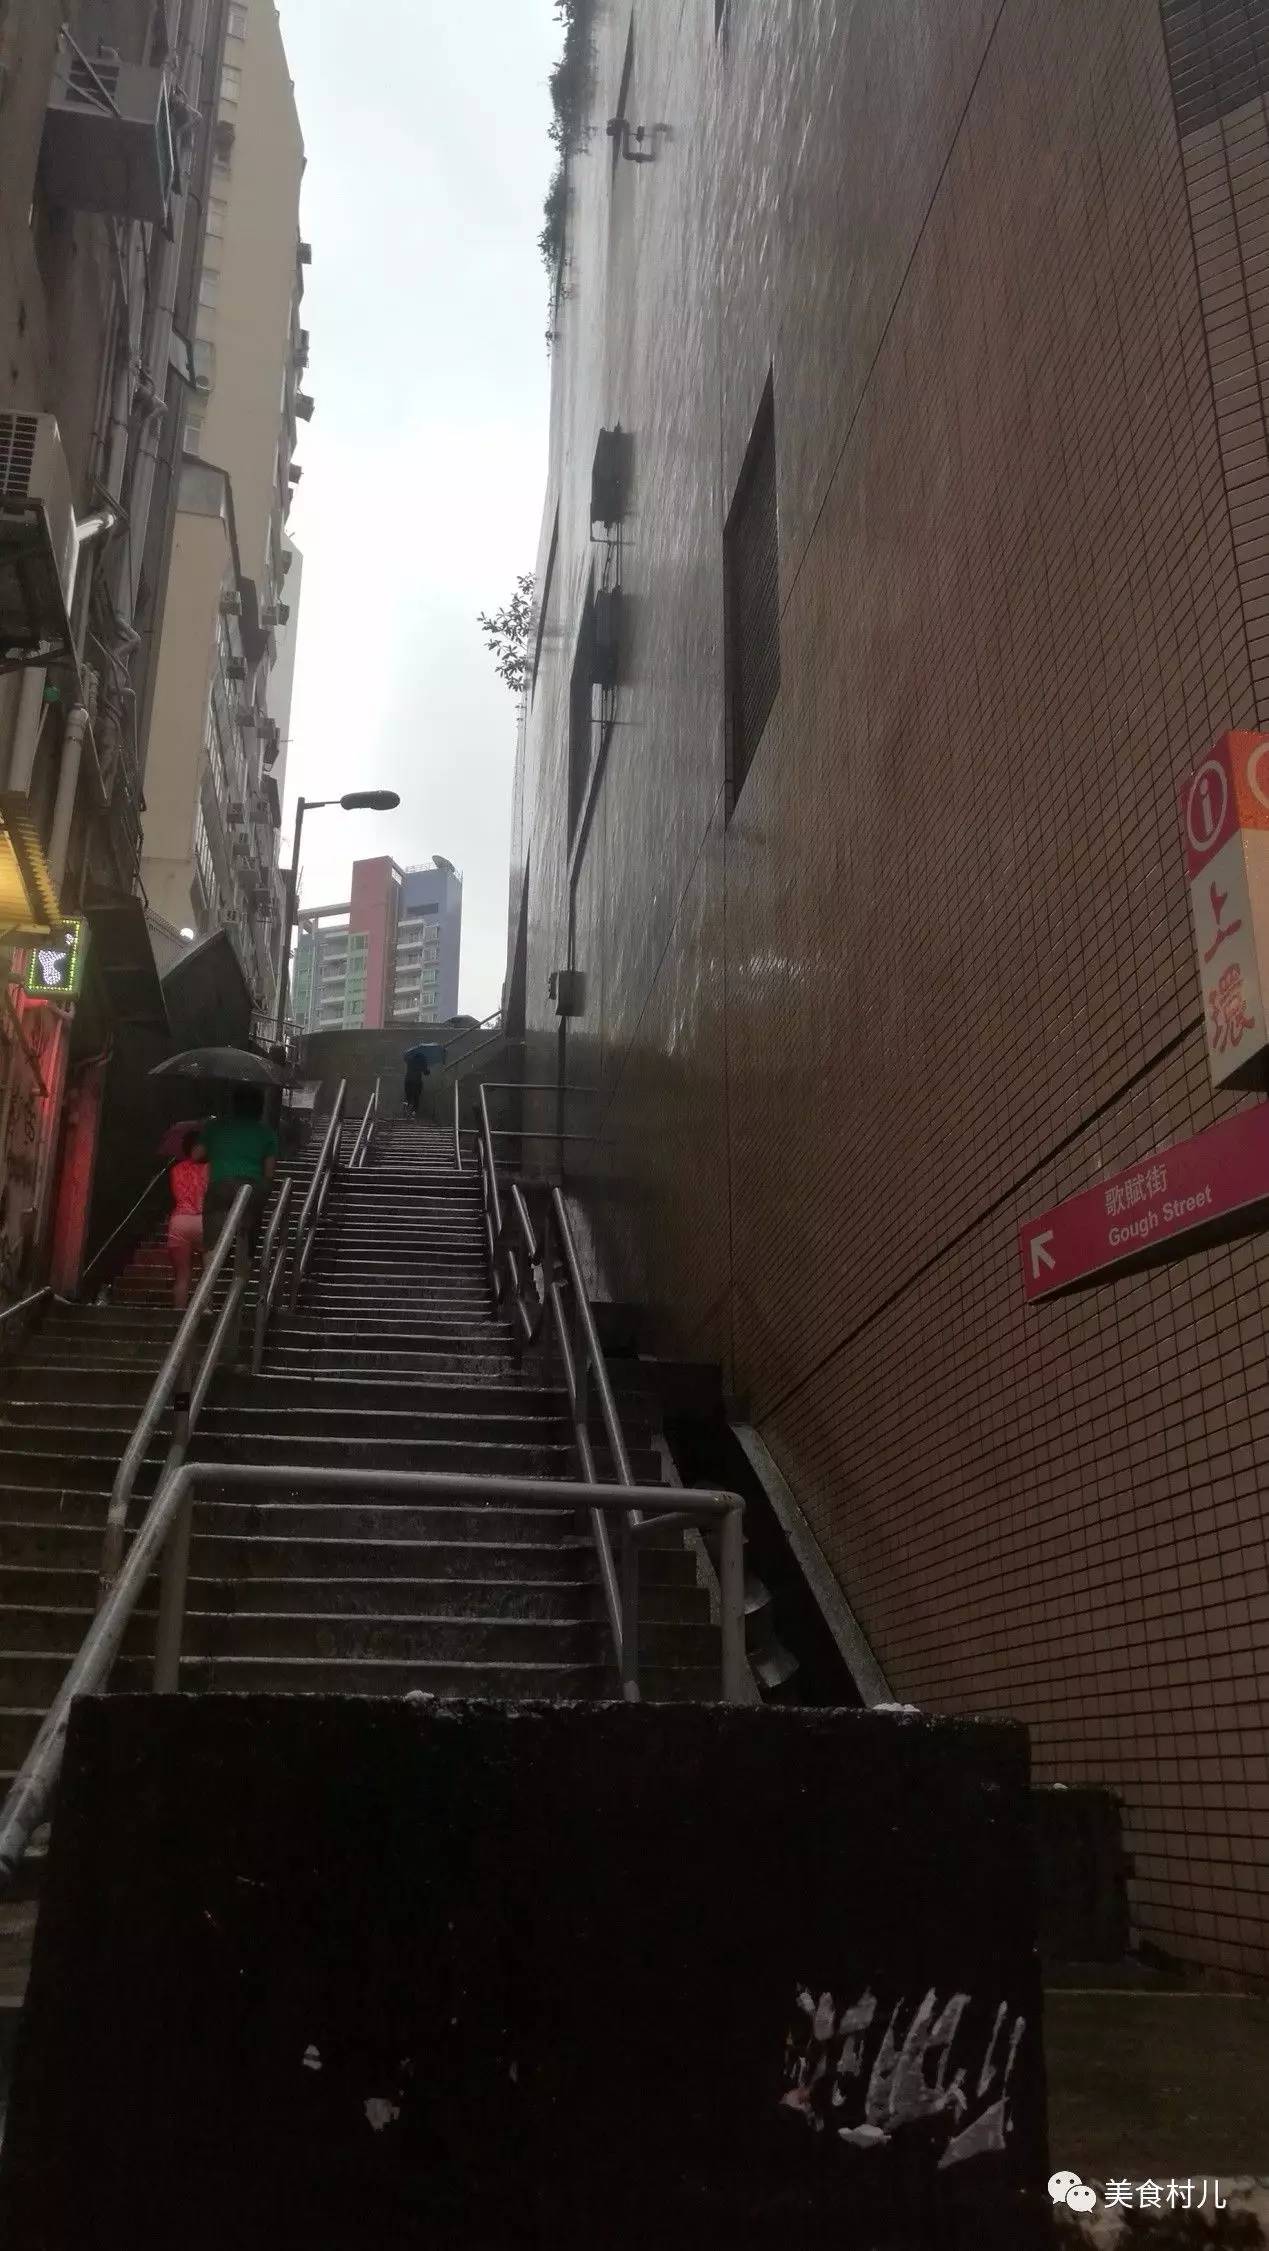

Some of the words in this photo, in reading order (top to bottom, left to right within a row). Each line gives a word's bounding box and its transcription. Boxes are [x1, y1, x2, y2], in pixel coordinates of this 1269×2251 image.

[1203, 880, 1255, 1053] 上環
[1104, 1164, 1168, 1217] 歌賦街
[1108, 1209, 1159, 1247] Gough
[1162, 1184, 1213, 1222] Street
